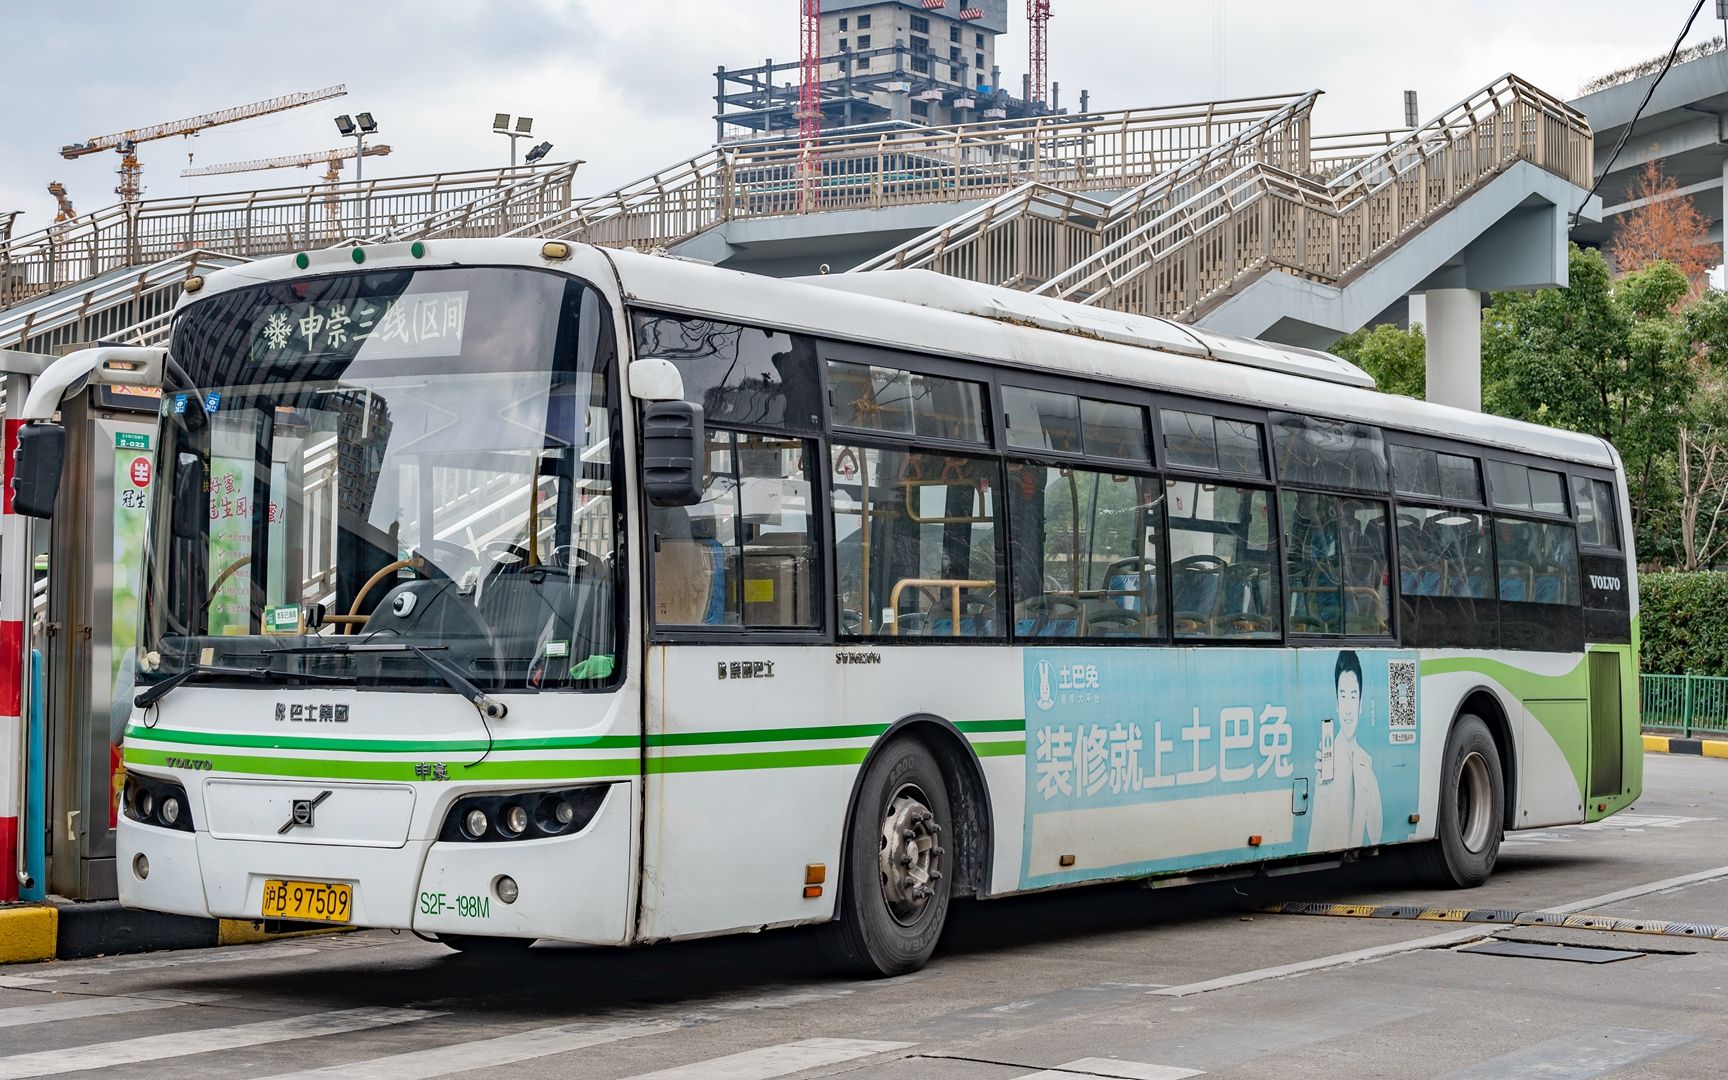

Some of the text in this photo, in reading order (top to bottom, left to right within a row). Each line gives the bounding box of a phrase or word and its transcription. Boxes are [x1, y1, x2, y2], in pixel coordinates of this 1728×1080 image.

[1589, 575, 1621, 591] VOLVO
[1059, 664, 1100, 689] 土巴兔
[165, 757, 213, 771] VOLVO
[1036, 703, 1295, 801] 装修就上土巴兔
[420, 892, 490, 918] S2F-198M
